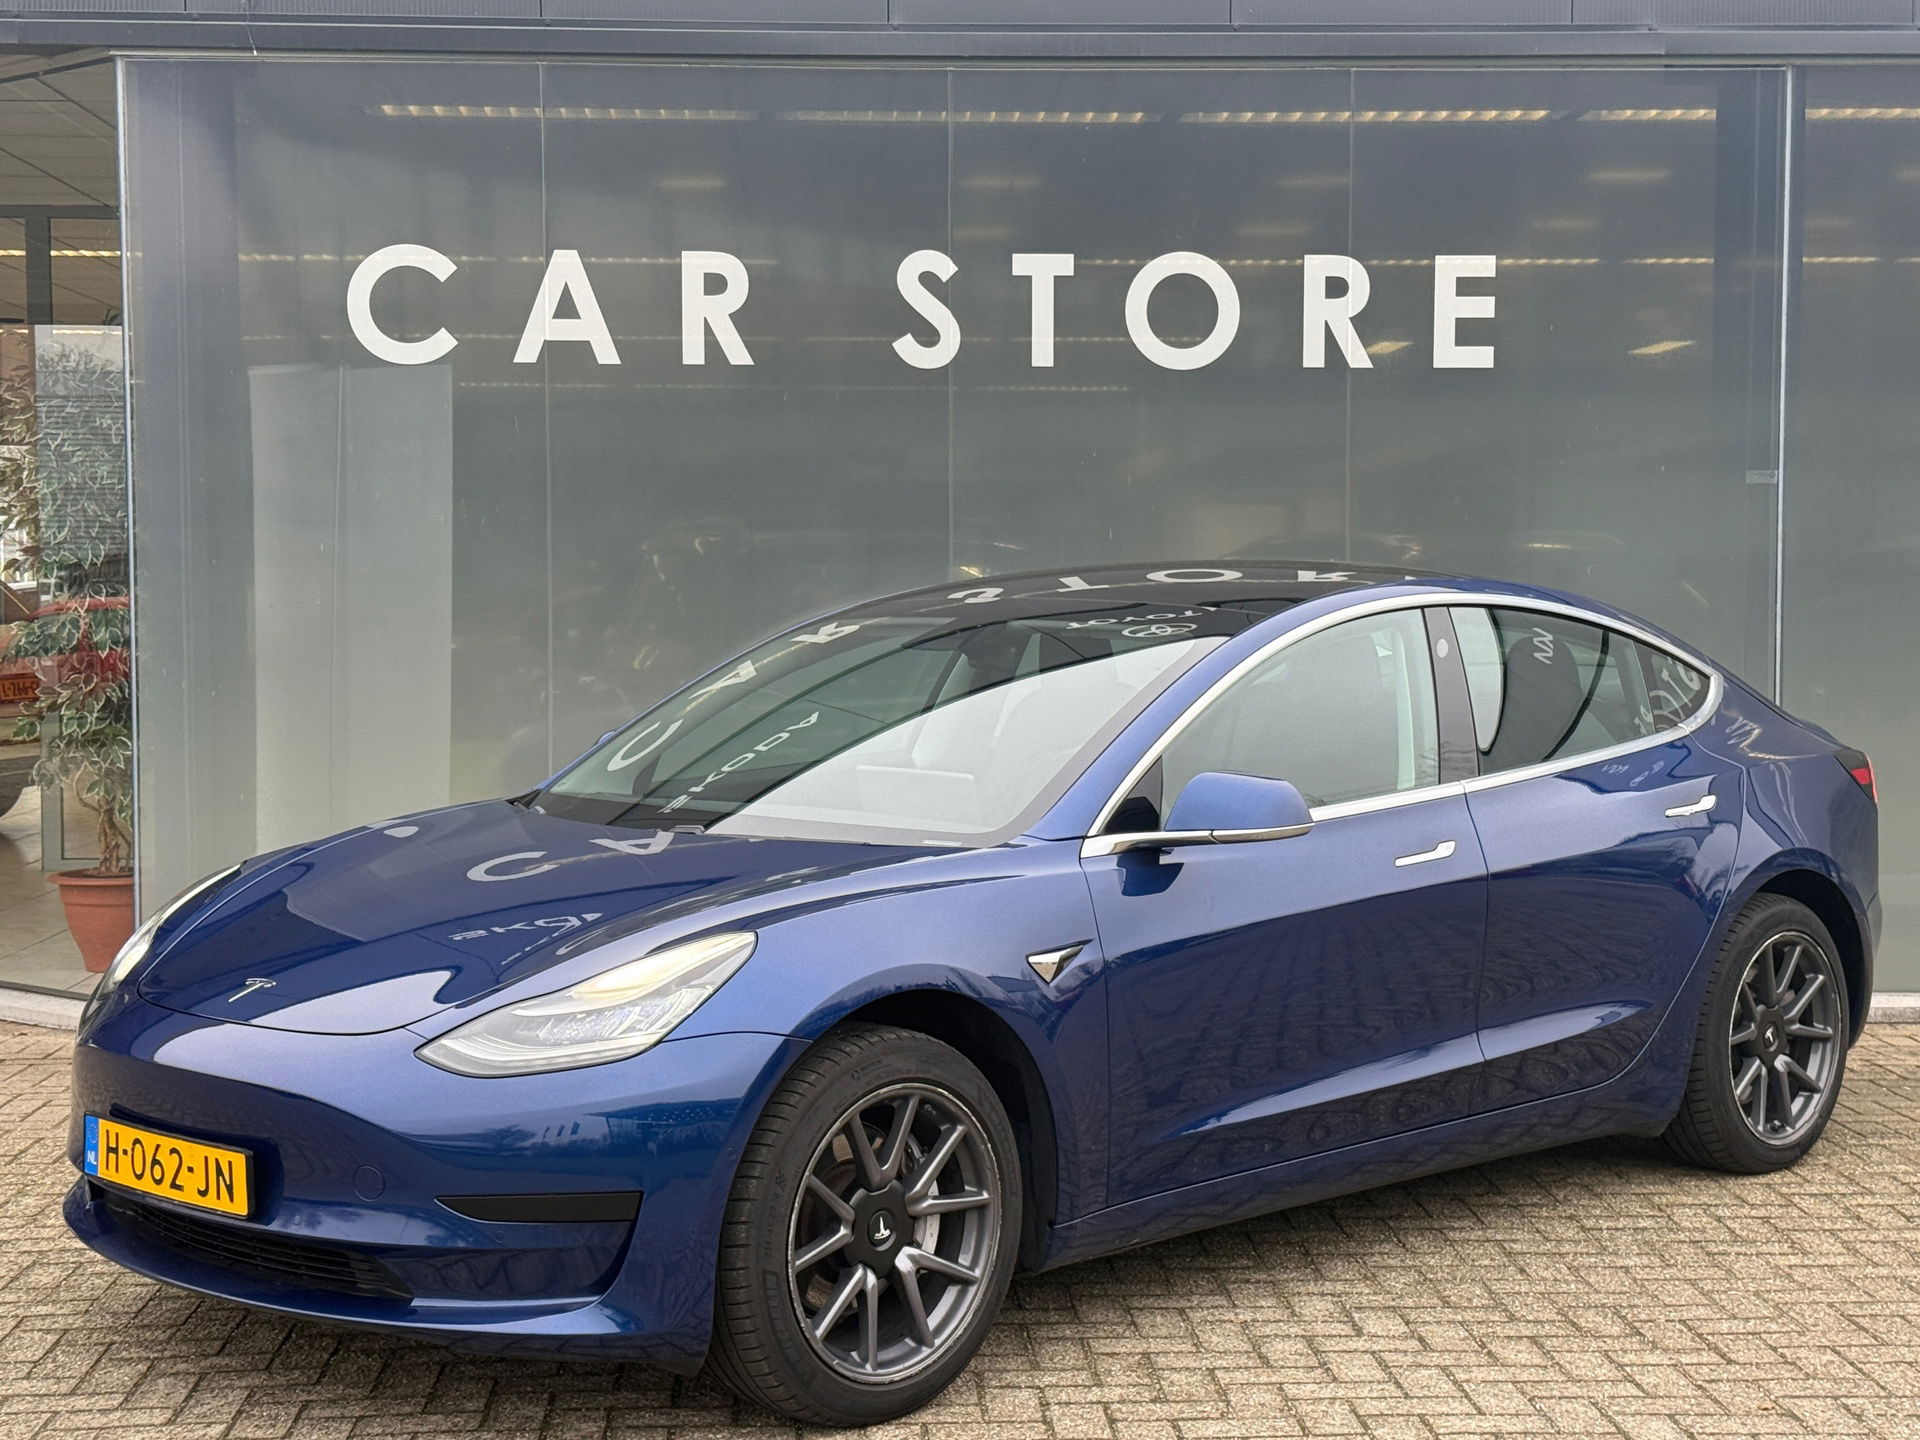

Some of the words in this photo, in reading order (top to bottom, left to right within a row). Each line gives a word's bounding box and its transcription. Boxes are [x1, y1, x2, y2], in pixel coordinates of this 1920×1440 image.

[347, 243, 755, 366] CAR
[892, 249, 1498, 371] STORE
[87, 1149, 97, 1165] NL
[105, 1128, 235, 1204] H-062-JN
